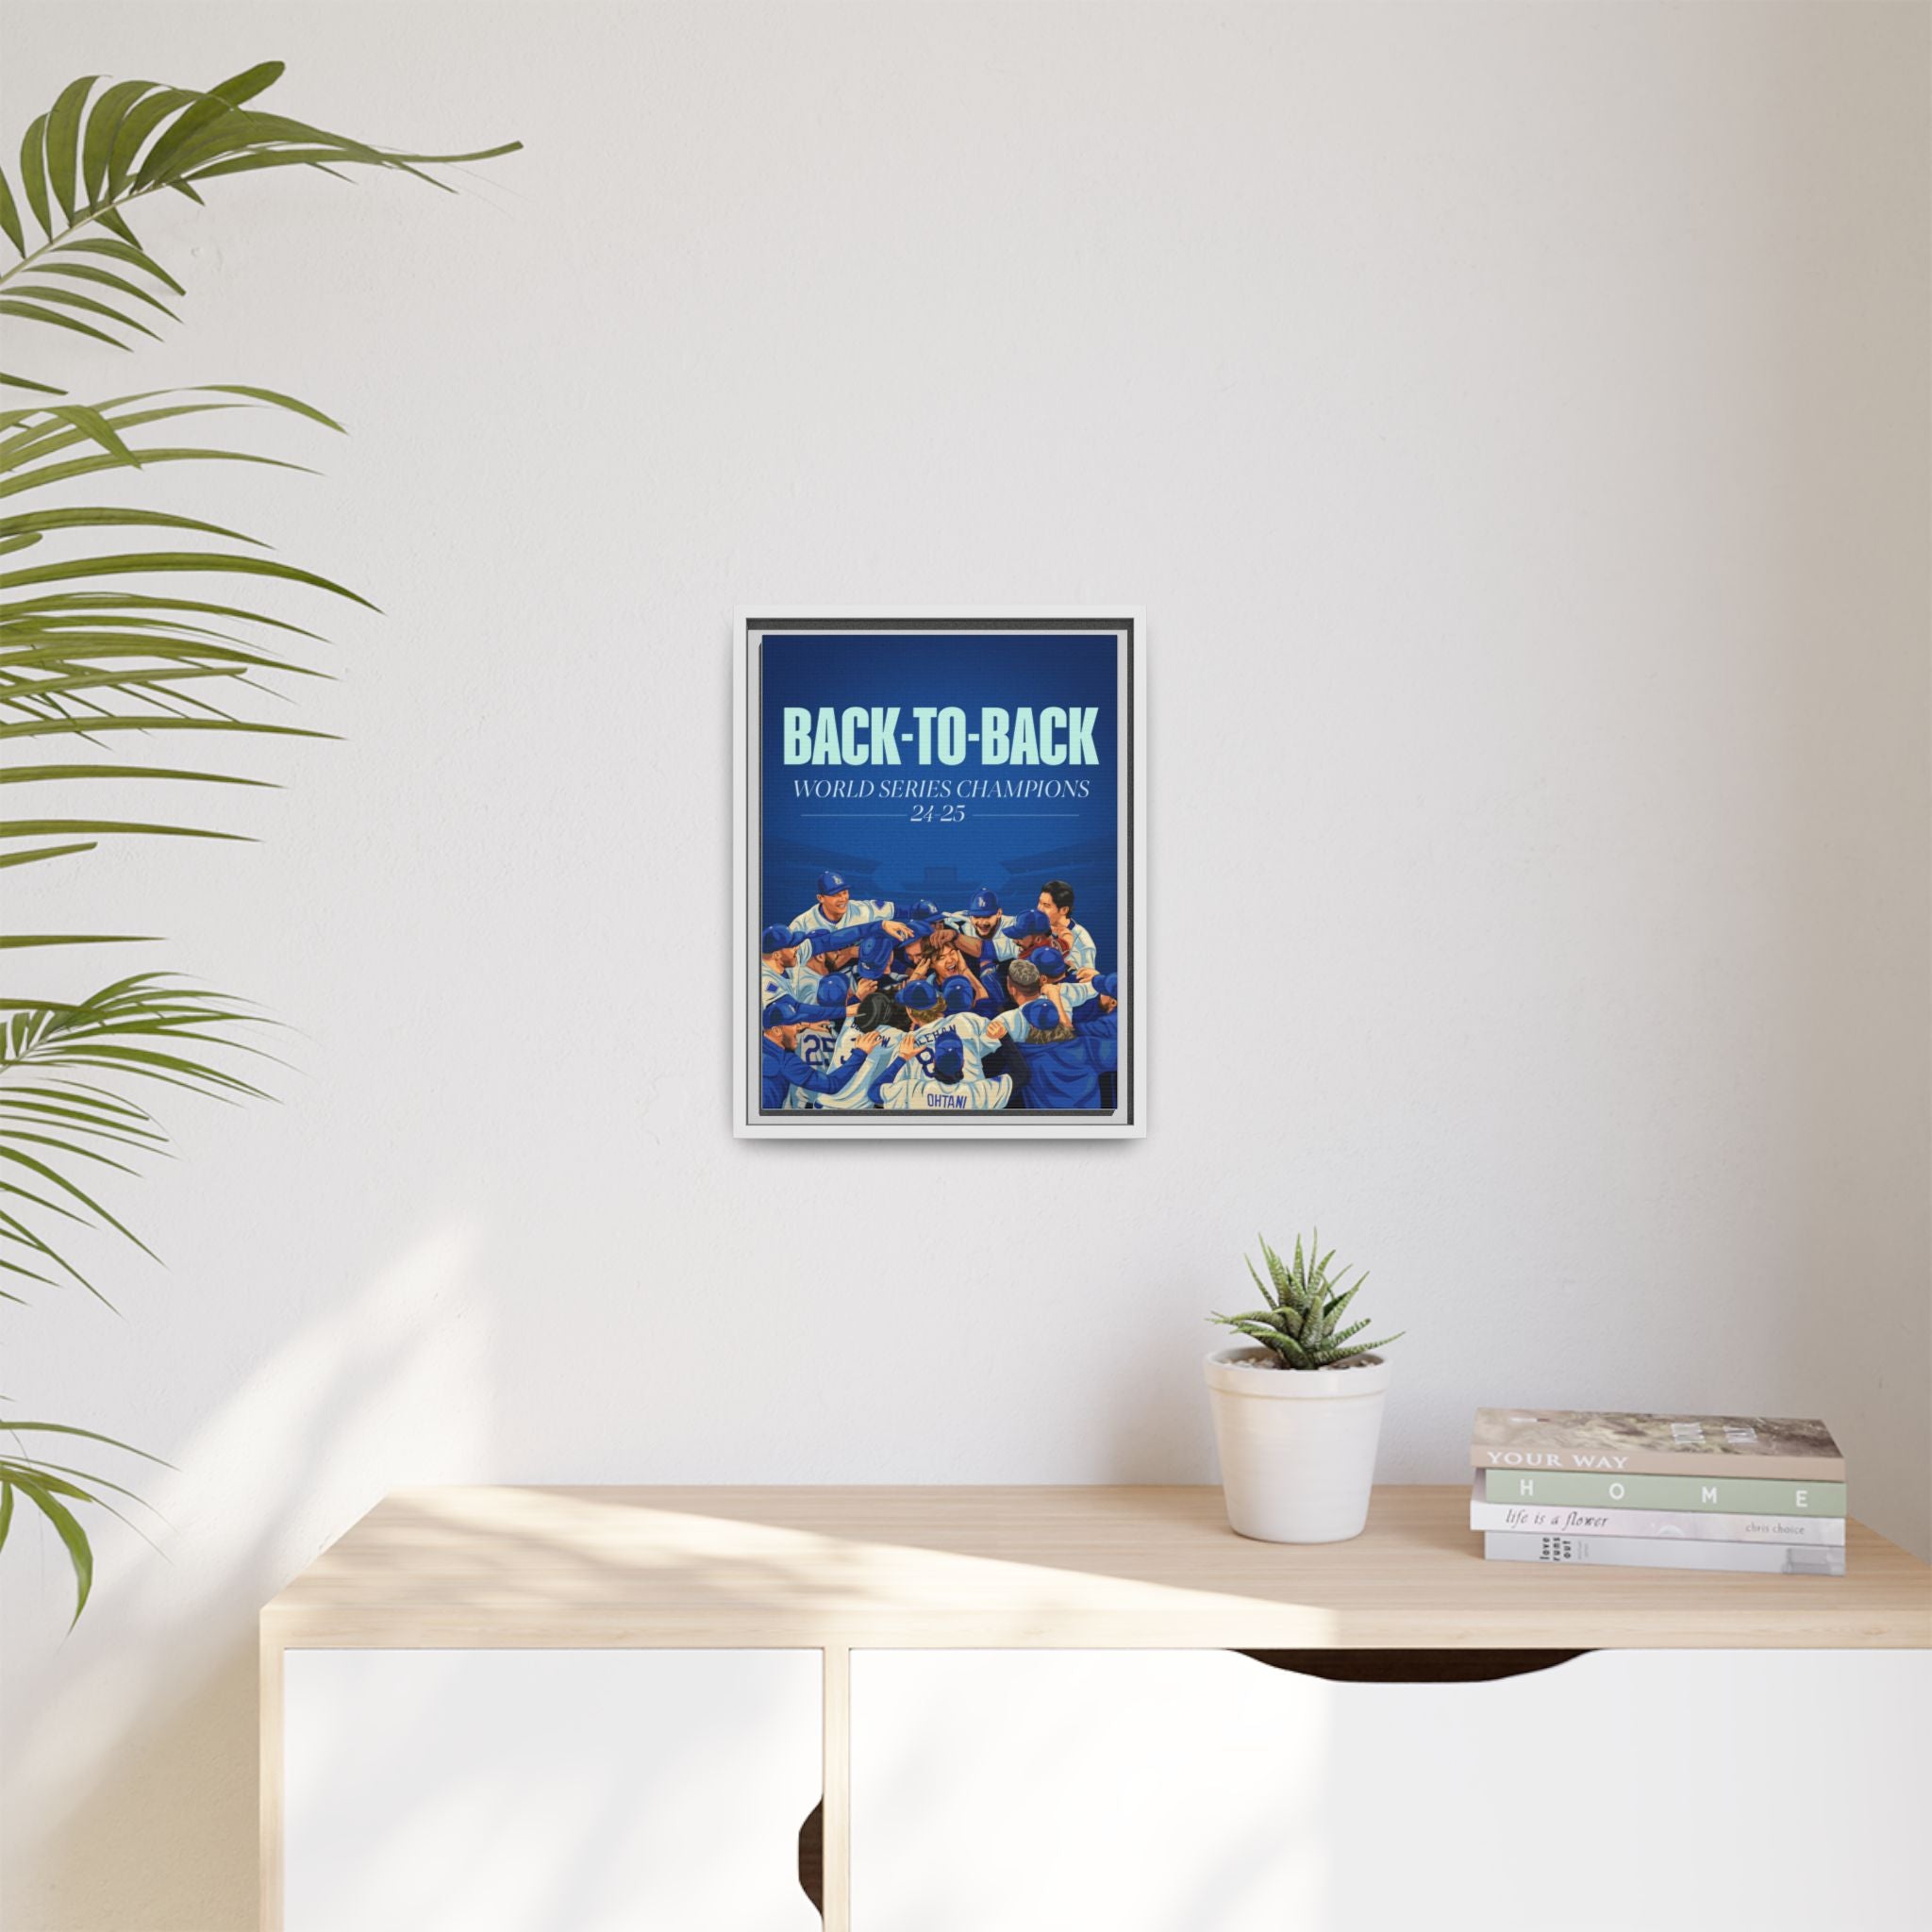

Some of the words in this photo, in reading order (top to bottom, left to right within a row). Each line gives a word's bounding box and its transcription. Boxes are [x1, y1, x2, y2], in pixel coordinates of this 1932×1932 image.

[783, 706, 1100, 766] BACK-TO-BACK
[793, 779, 874, 799] WORLD
[878, 779, 952, 799] SERIES
[956, 779, 1091, 799] CHAMPIONS
[909, 804, 966, 823] 24-25
[926, 1093, 967, 1109] OHTANI
[1487, 1451, 1562, 1467] YOUR
[1573, 1455, 1629, 1469] WAY
[1506, 1509, 1528, 1529] life
[1534, 1513, 1547, 1524] is
[1551, 1516, 1559, 1525] a
[1561, 1511, 1609, 1532] flower
[1745, 1521, 1770, 1533] chris
[1772, 1523, 1806, 1536] choice
[1540, 1537, 1550, 1559] love
[1562, 1541, 1571, 1559] out
